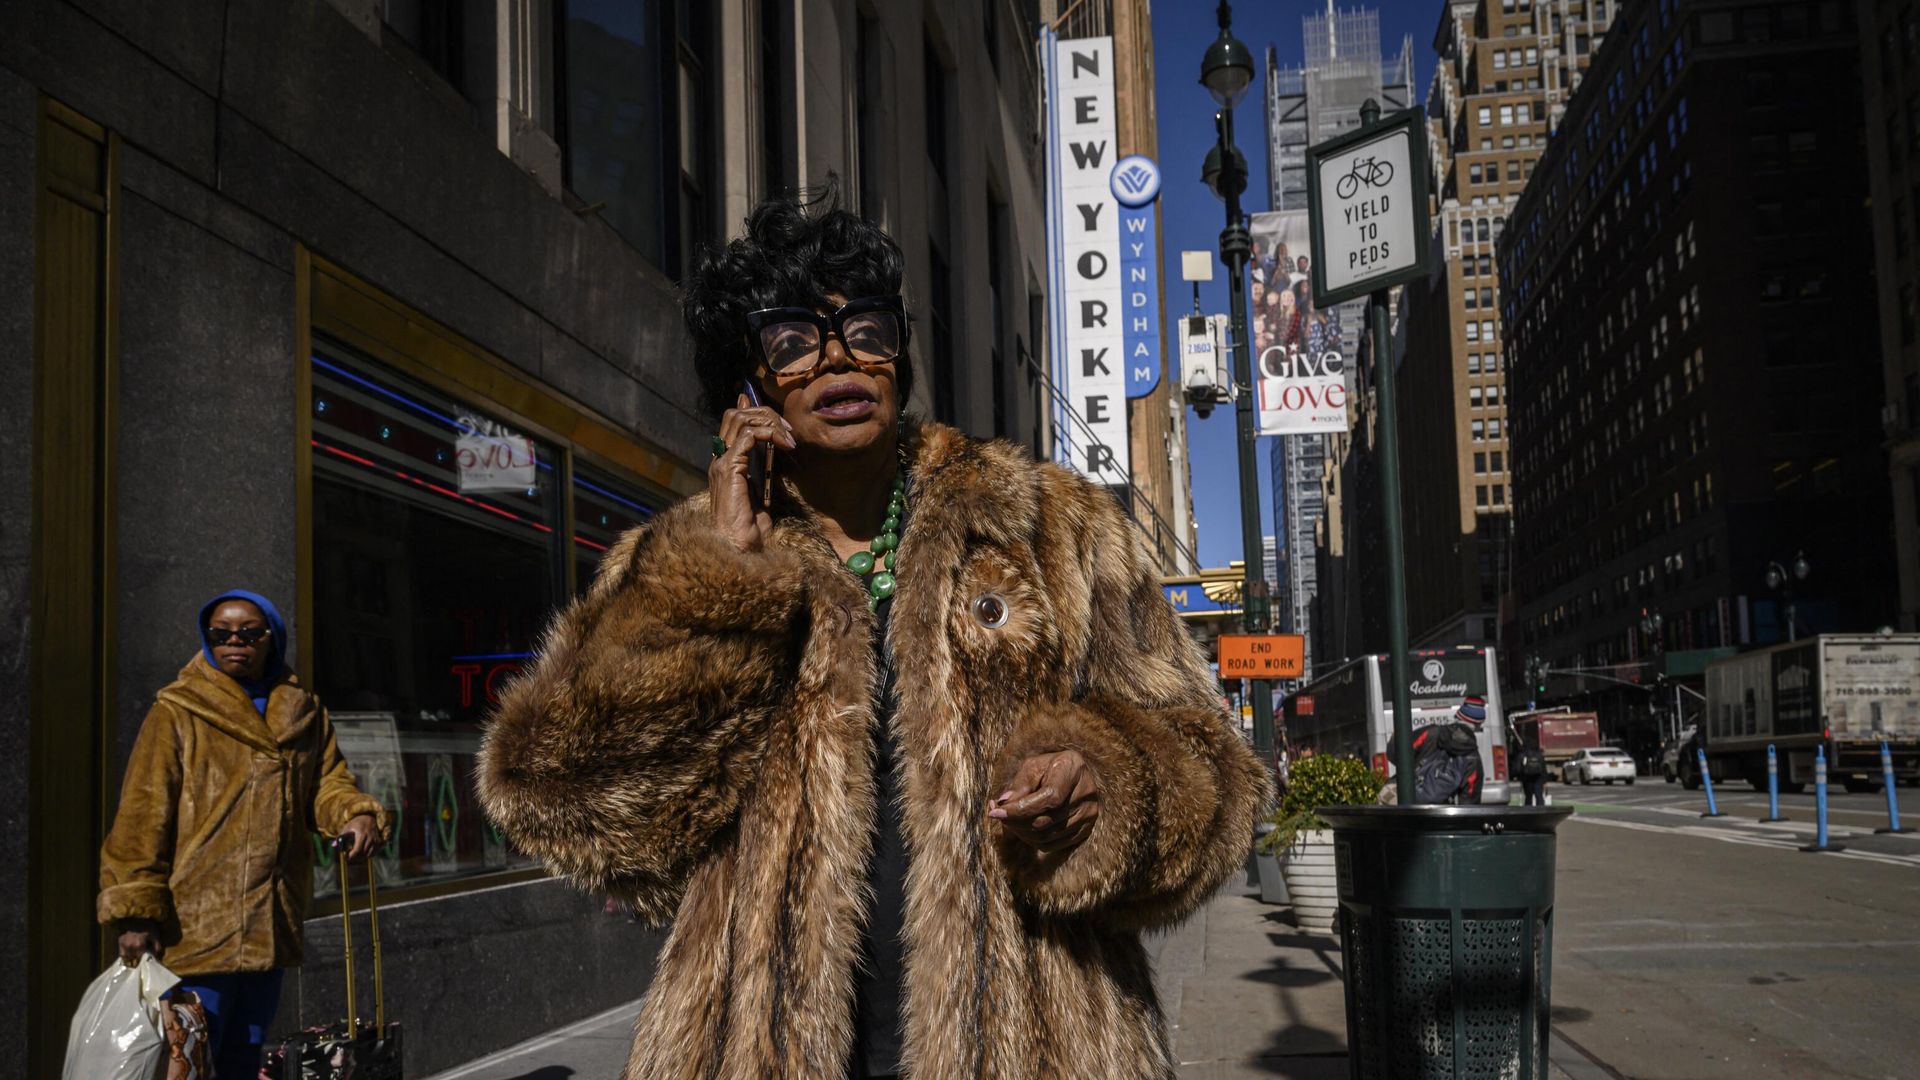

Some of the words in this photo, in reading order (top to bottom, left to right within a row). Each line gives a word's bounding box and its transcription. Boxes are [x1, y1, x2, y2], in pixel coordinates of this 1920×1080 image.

[1068, 49, 1107, 169] NEW
[1344, 195, 1390, 225] YIELD
[1359, 222, 1377, 243] TO
[1349, 241, 1390, 270] PEDS
[1126, 217, 1151, 382] WYNDHAM
[1076, 202, 1114, 473] YORKER
[1259, 342, 1344, 380] Give
[1258, 379, 1346, 412] Love
[1250, 642, 1272, 654] END
[1227, 658, 1256, 670] ROAD
[1264, 658, 1295, 670] WORK
[1409, 680, 1467, 696] Academy
